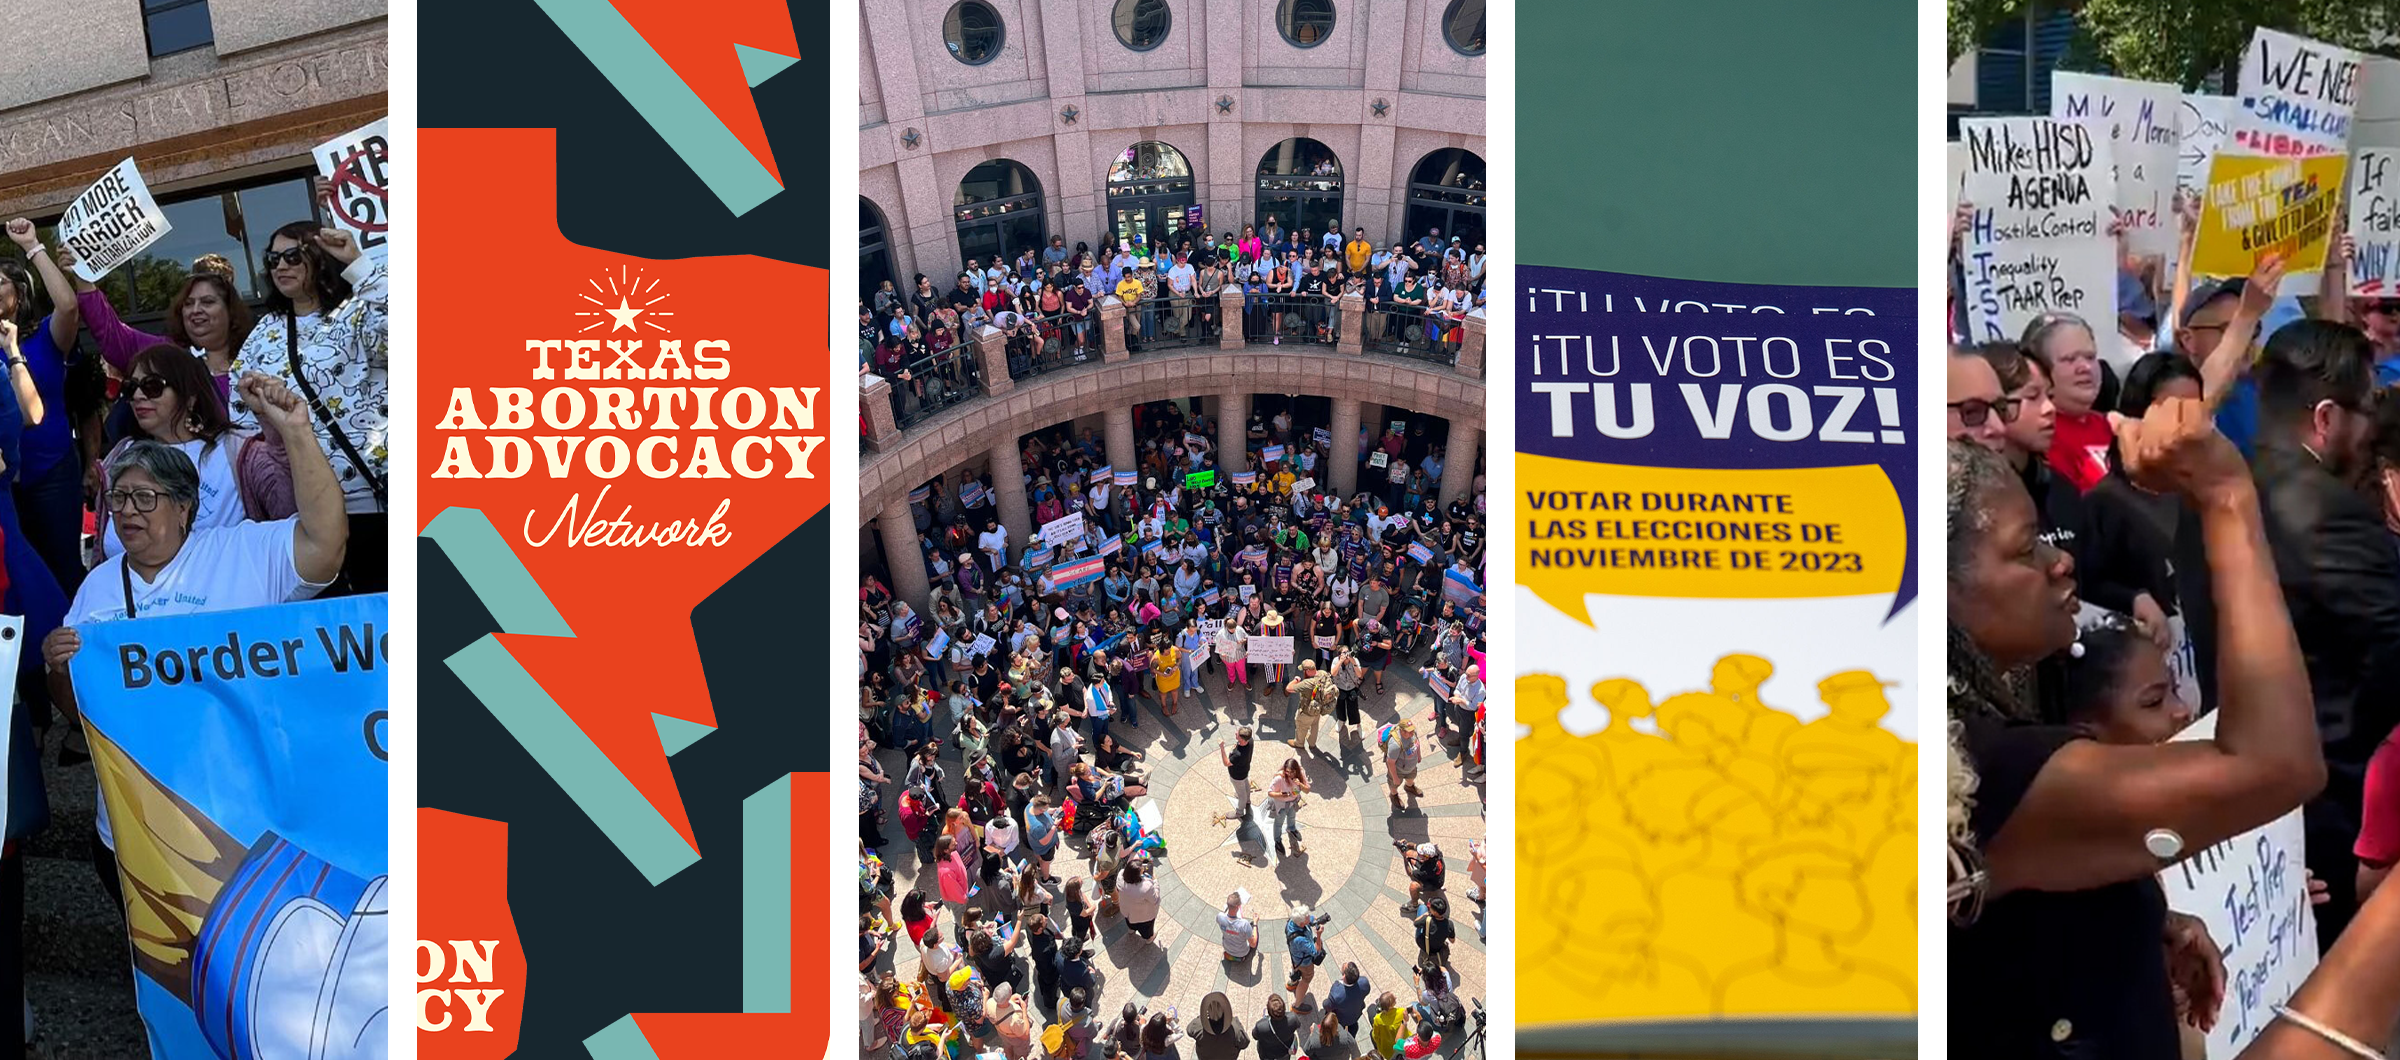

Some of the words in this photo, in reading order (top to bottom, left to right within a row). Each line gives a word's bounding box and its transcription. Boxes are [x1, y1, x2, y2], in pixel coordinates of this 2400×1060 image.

[2260, 39, 2321, 95] WE
[119, 77, 247, 132] STATE
[2255, 95, 2318, 132] SMALL
[2033, 120, 2093, 174] HISD
[2007, 172, 2091, 210] AGENDA
[2358, 151, 2391, 196] If
[63, 205, 81, 237] NO
[81, 167, 130, 218] MORE
[67, 194, 146, 261] BORDER
[86, 221, 157, 275] MILITARIZATION
[1974, 208, 2040, 245] Hostile
[2041, 211, 2097, 239] Control
[1973, 251, 2059, 287] Inequality
[2351, 239, 2391, 282] WHY
[2050, 276, 2085, 310] Prep
[526, 340, 731, 380] TEXAS
[1530, 335, 1621, 377] ¡TU
[1641, 335, 1802, 380] VOTO
[1824, 338, 1896, 382] ES
[436, 387, 821, 430] ABORTION
[1531, 382, 1655, 439] TU
[1679, 383, 1906, 444] VOZ!
[431, 436, 826, 479] ADVOCACY
[523, 485, 733, 548] Network
[1526, 491, 1633, 511] VOTAR
[1641, 492, 1795, 514] DURANTE
[1528, 520, 1587, 540] LAS
[1596, 520, 1793, 543] ELECCIONES
[1801, 524, 1844, 544] DE
[1530, 549, 1722, 569] NOVIEMBRE
[1730, 551, 1772, 570] DE
[1779, 551, 1864, 573] 2023
[118, 631, 303, 690] Border
[2225, 864, 2261, 947] Test
[2256, 834, 2286, 910] Prep
